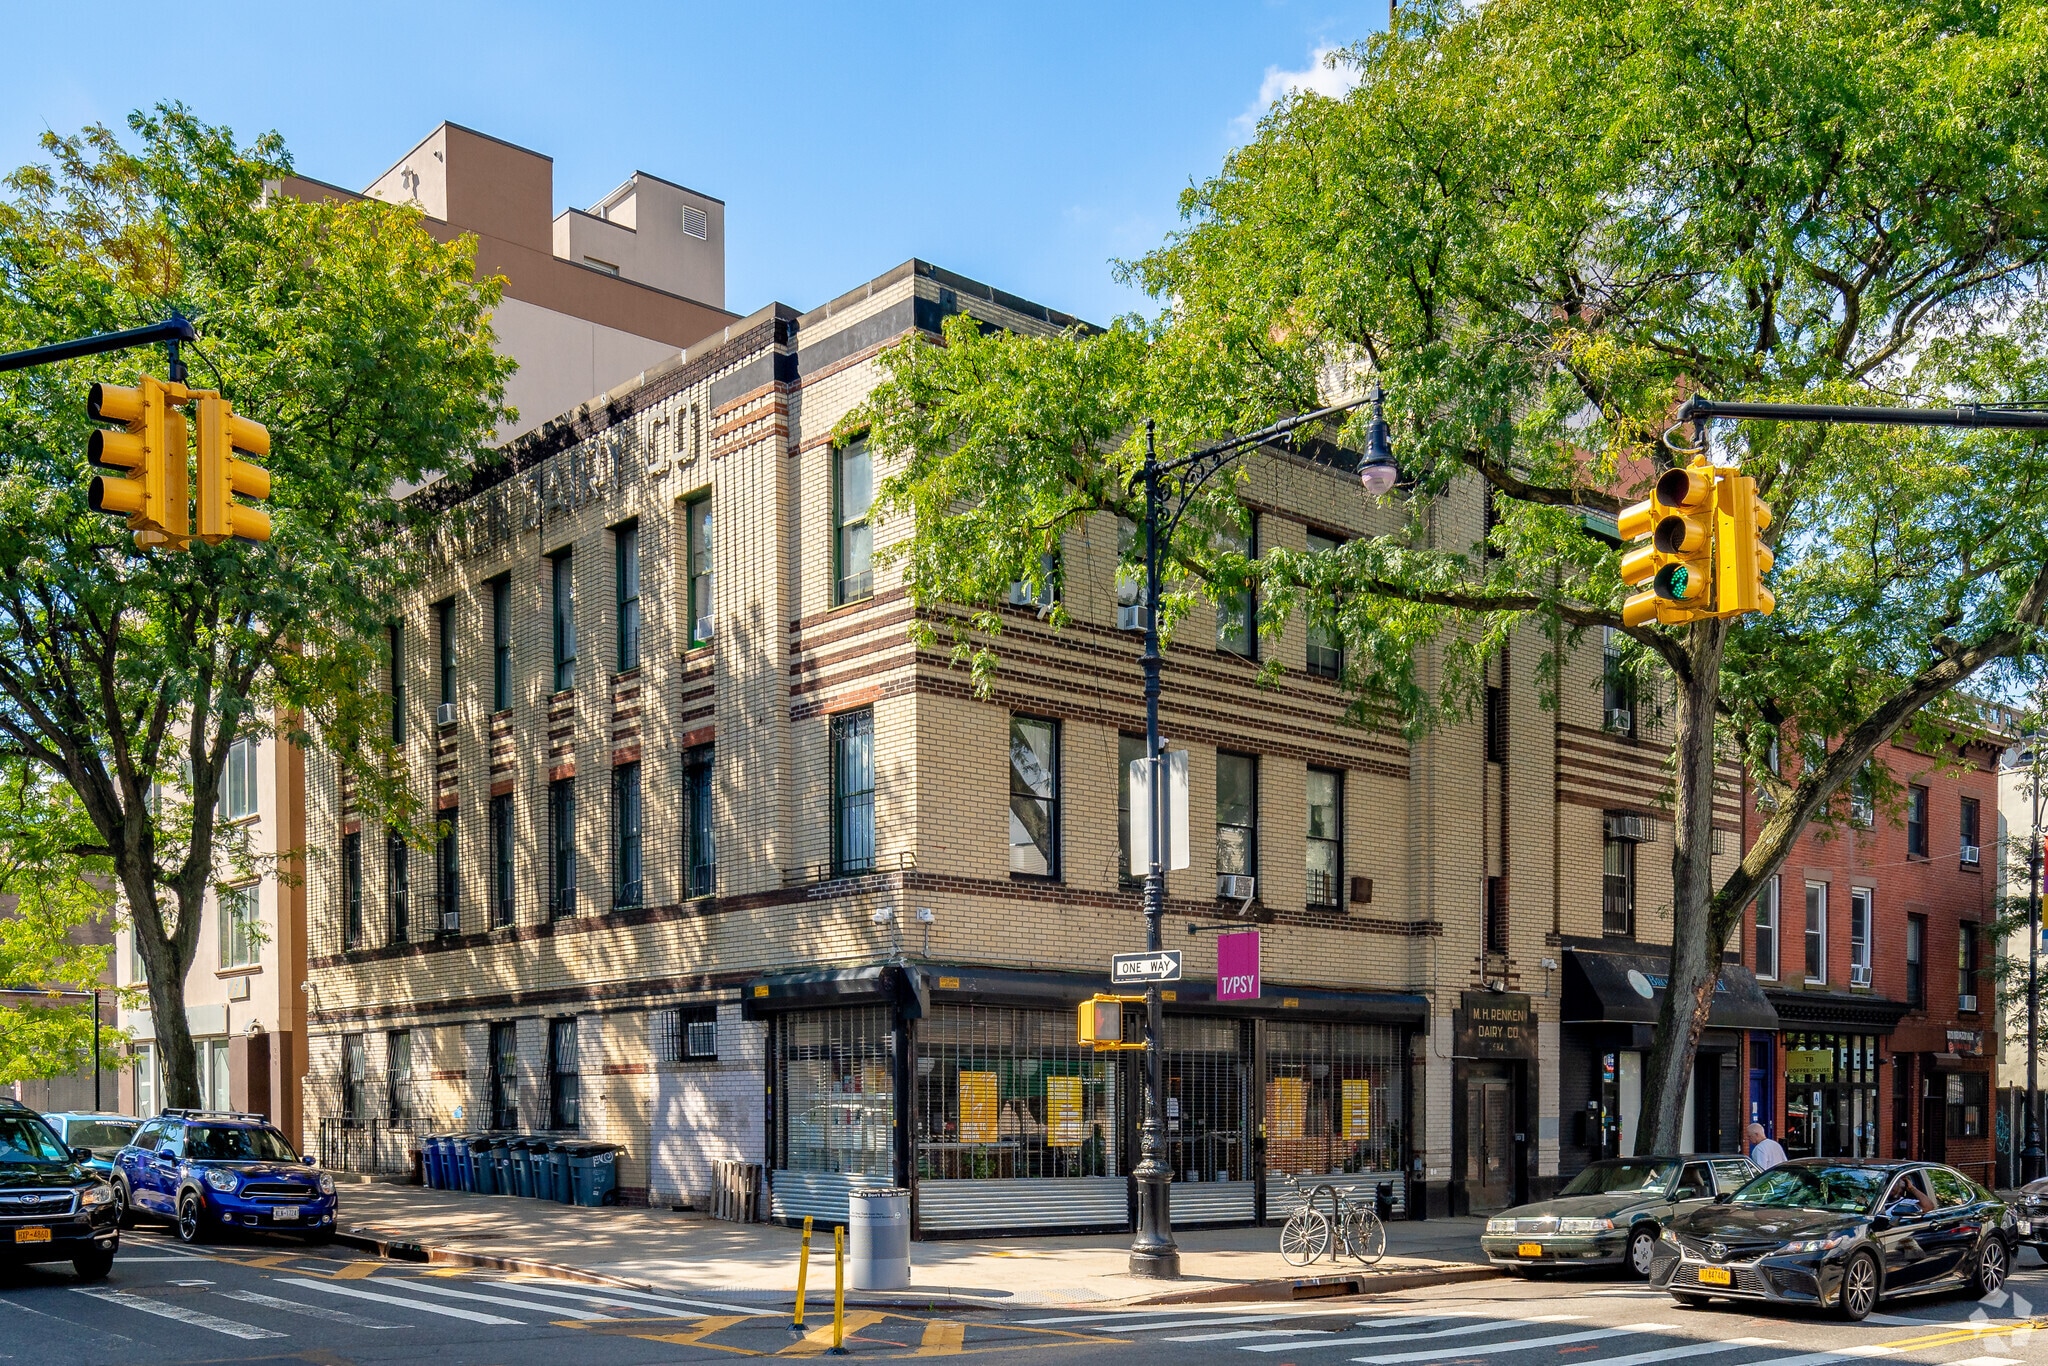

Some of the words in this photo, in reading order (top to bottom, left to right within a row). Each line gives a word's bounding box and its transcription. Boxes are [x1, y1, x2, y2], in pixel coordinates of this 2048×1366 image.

[644, 397, 691, 474] CO
[1122, 962, 1142, 974] ONE
[1150, 960, 1171, 972] WAY
[1221, 975, 1254, 994] T/PSY
[1491, 1009, 1524, 1021] RENKEN
[1478, 1025, 1503, 1038] DAIRY
